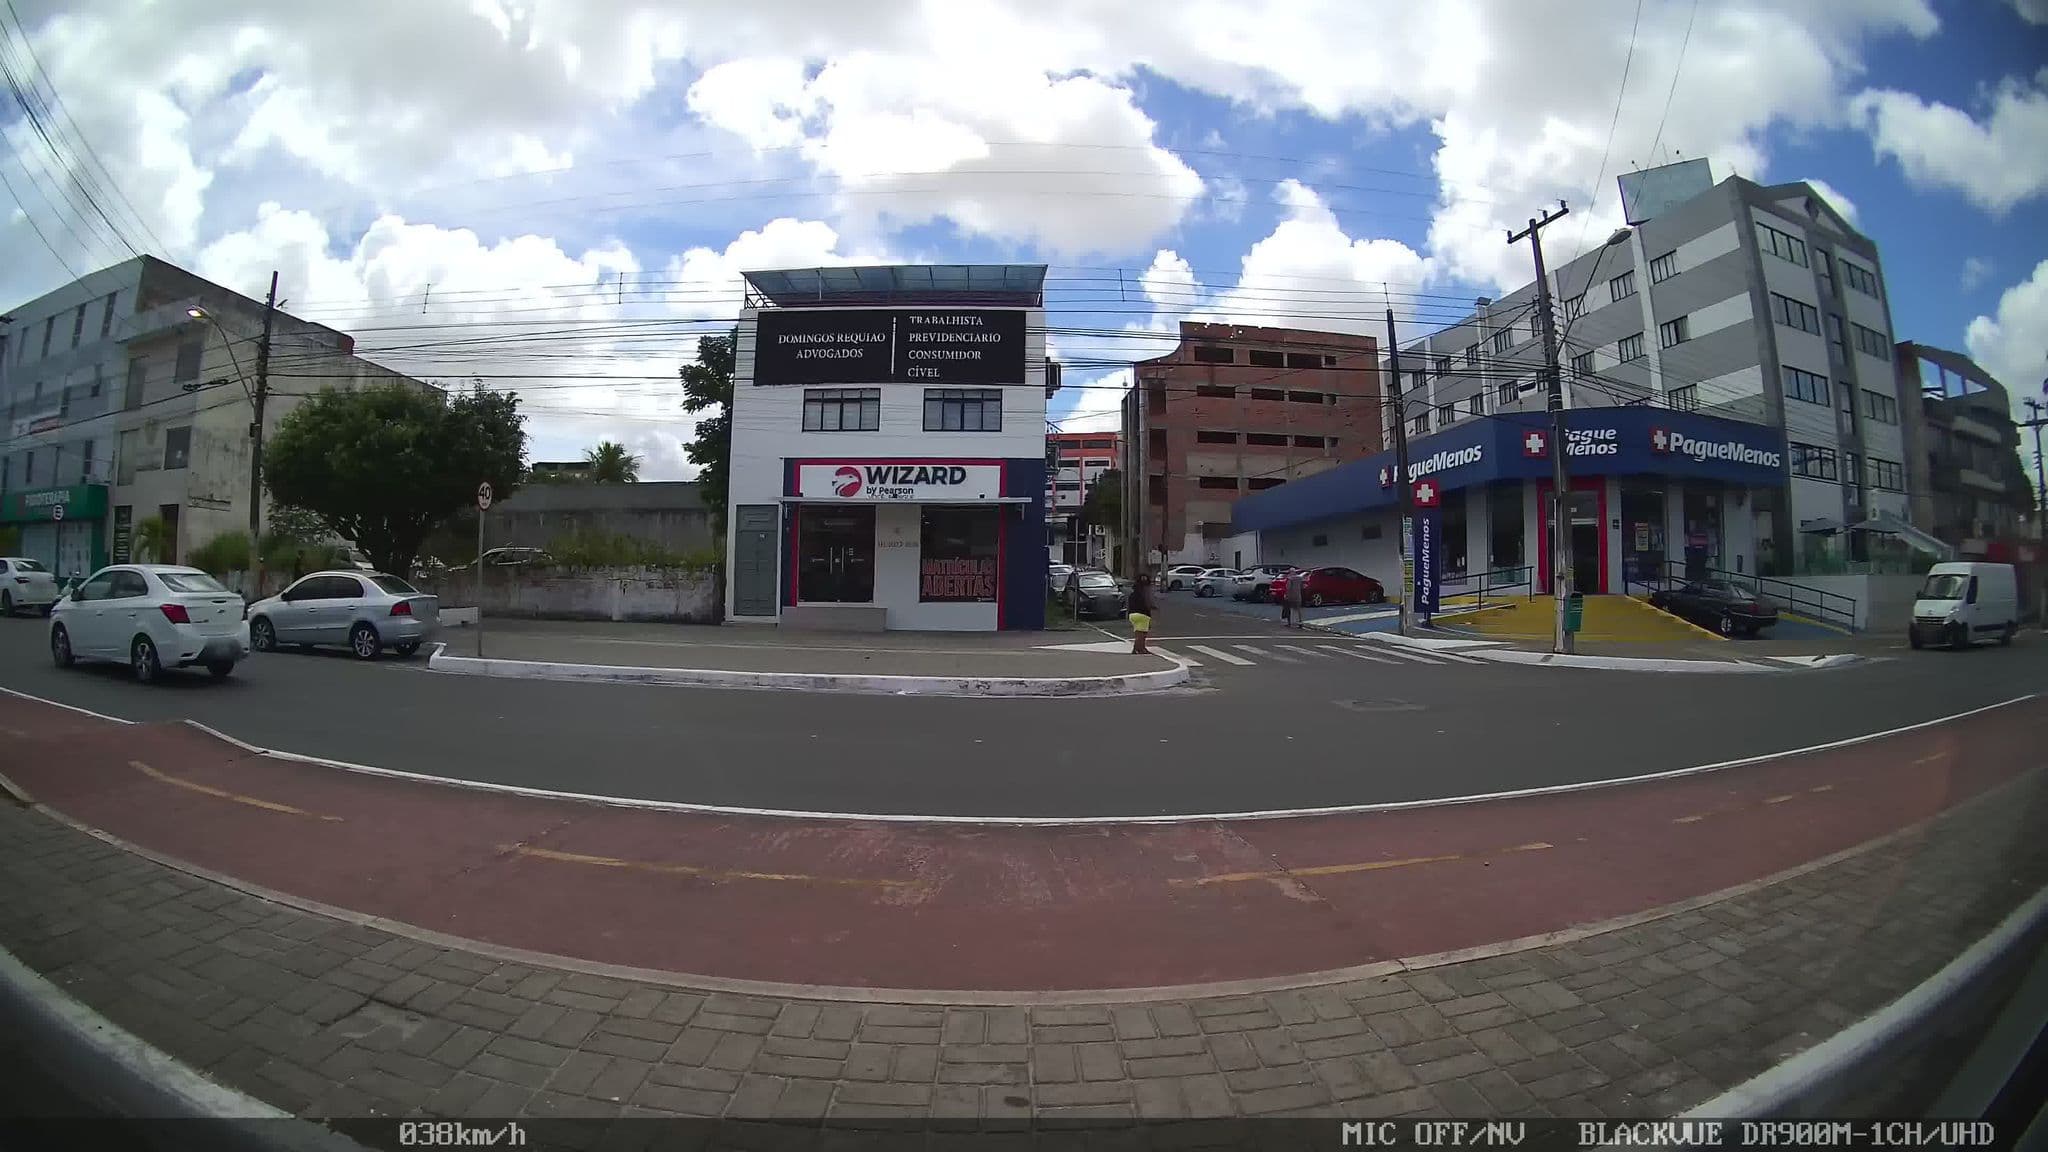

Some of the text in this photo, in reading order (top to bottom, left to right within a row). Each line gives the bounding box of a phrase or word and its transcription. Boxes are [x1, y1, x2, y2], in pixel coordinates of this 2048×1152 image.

[909, 315, 984, 326] TRABALHISTA
[778, 333, 835, 344] DOMINGOS
[795, 348, 864, 359] ADVOGADOS
[908, 350, 982, 360] CONSUMIDOR
[1564, 428, 1617, 445] ague
[1669, 431, 1781, 468] PagueMenos
[864, 465, 967, 486] WIZARD
[479, 486, 491, 500] 40
[865, 486, 914, 495] by Pearson
[1421, 517, 1432, 605] PagueMenos
[921, 575, 995, 597] ABERTAS
